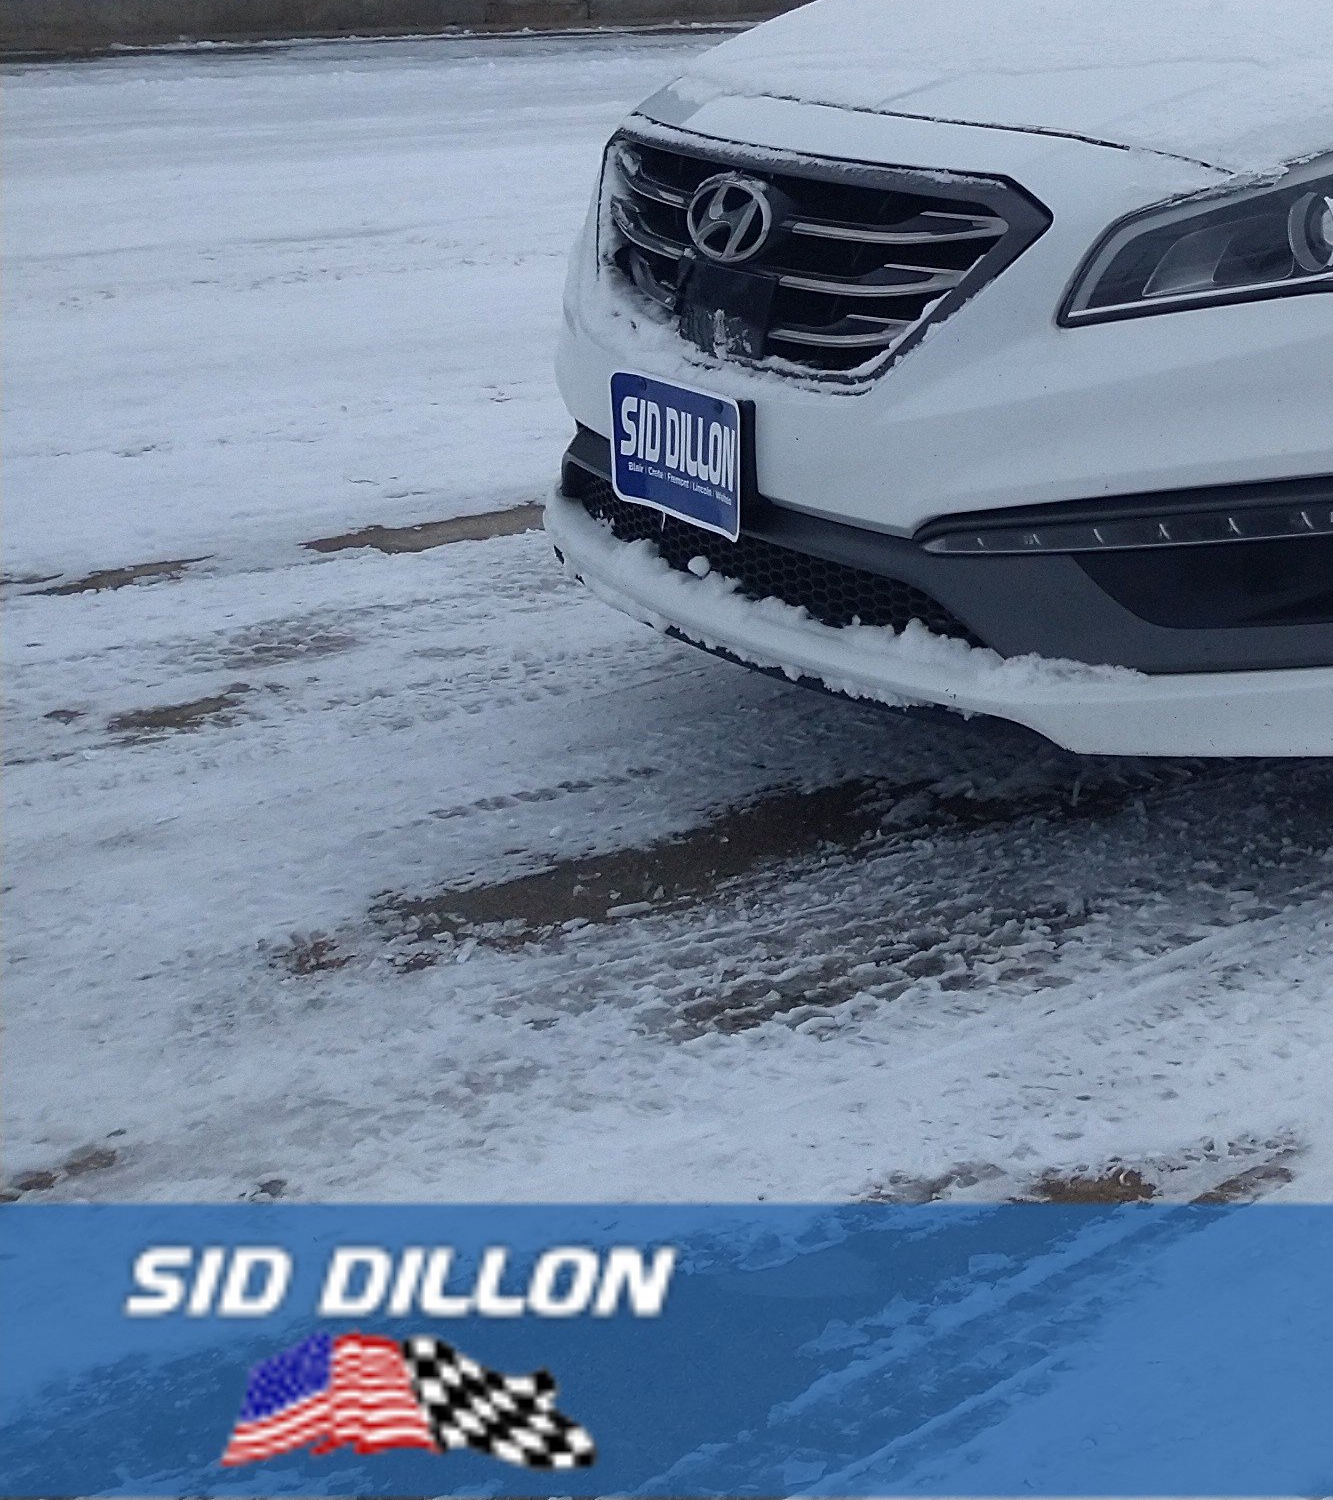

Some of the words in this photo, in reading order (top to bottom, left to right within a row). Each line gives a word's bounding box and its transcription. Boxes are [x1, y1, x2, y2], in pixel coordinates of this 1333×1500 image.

[620, 396, 661, 463] SID
[665, 406, 736, 492] DILLON
[628, 461, 643, 473] Blair
